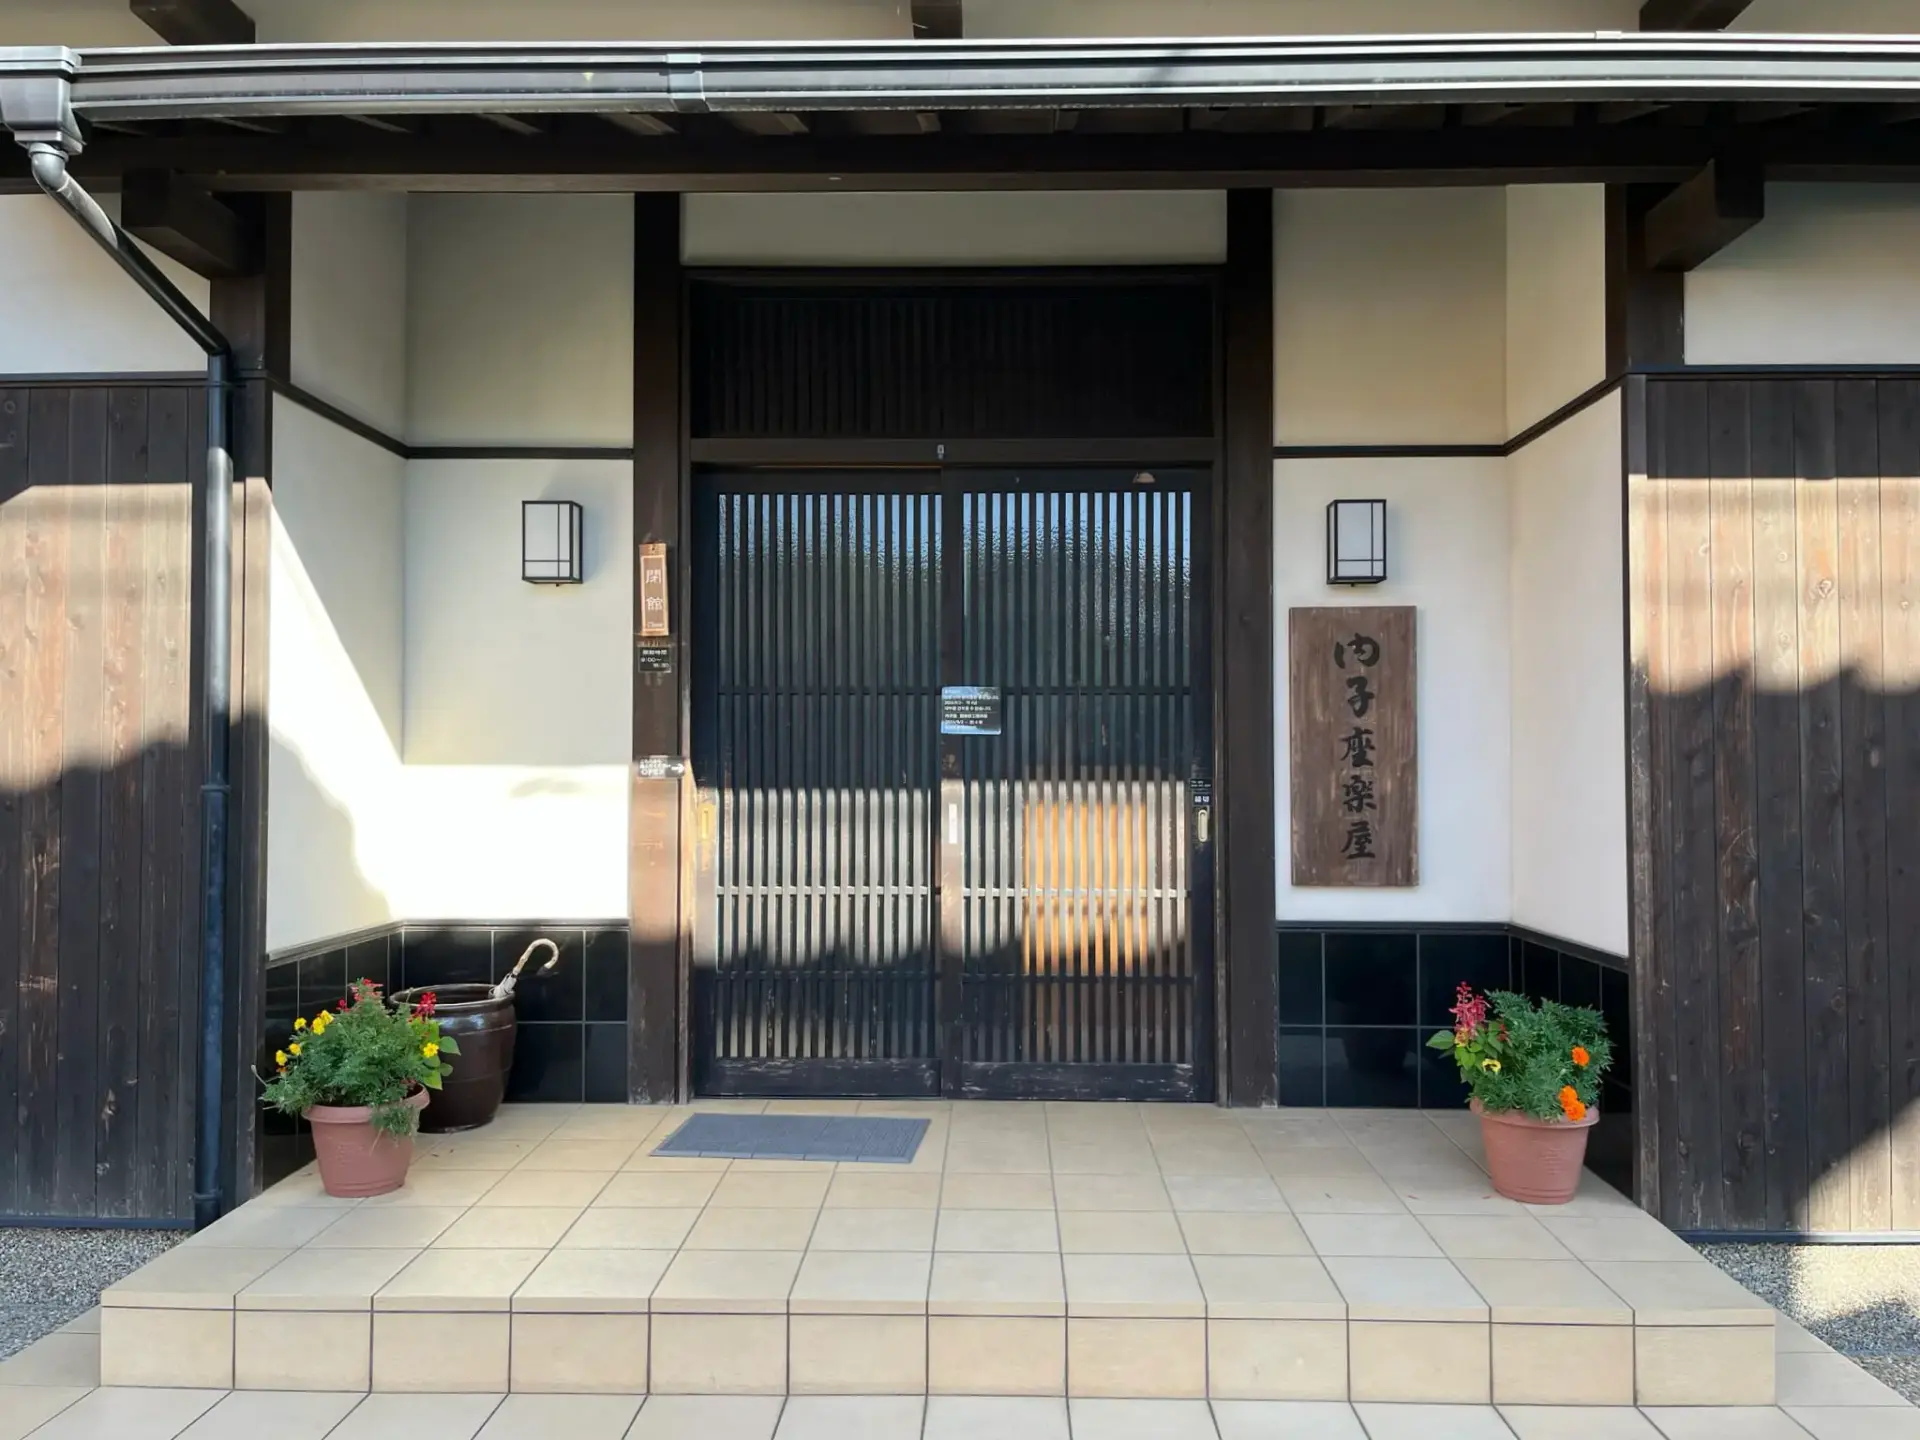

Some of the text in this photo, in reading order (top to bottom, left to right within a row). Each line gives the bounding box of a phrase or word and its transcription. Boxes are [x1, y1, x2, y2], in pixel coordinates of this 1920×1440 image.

[1333, 632, 1380, 860] 内子座楽屋
